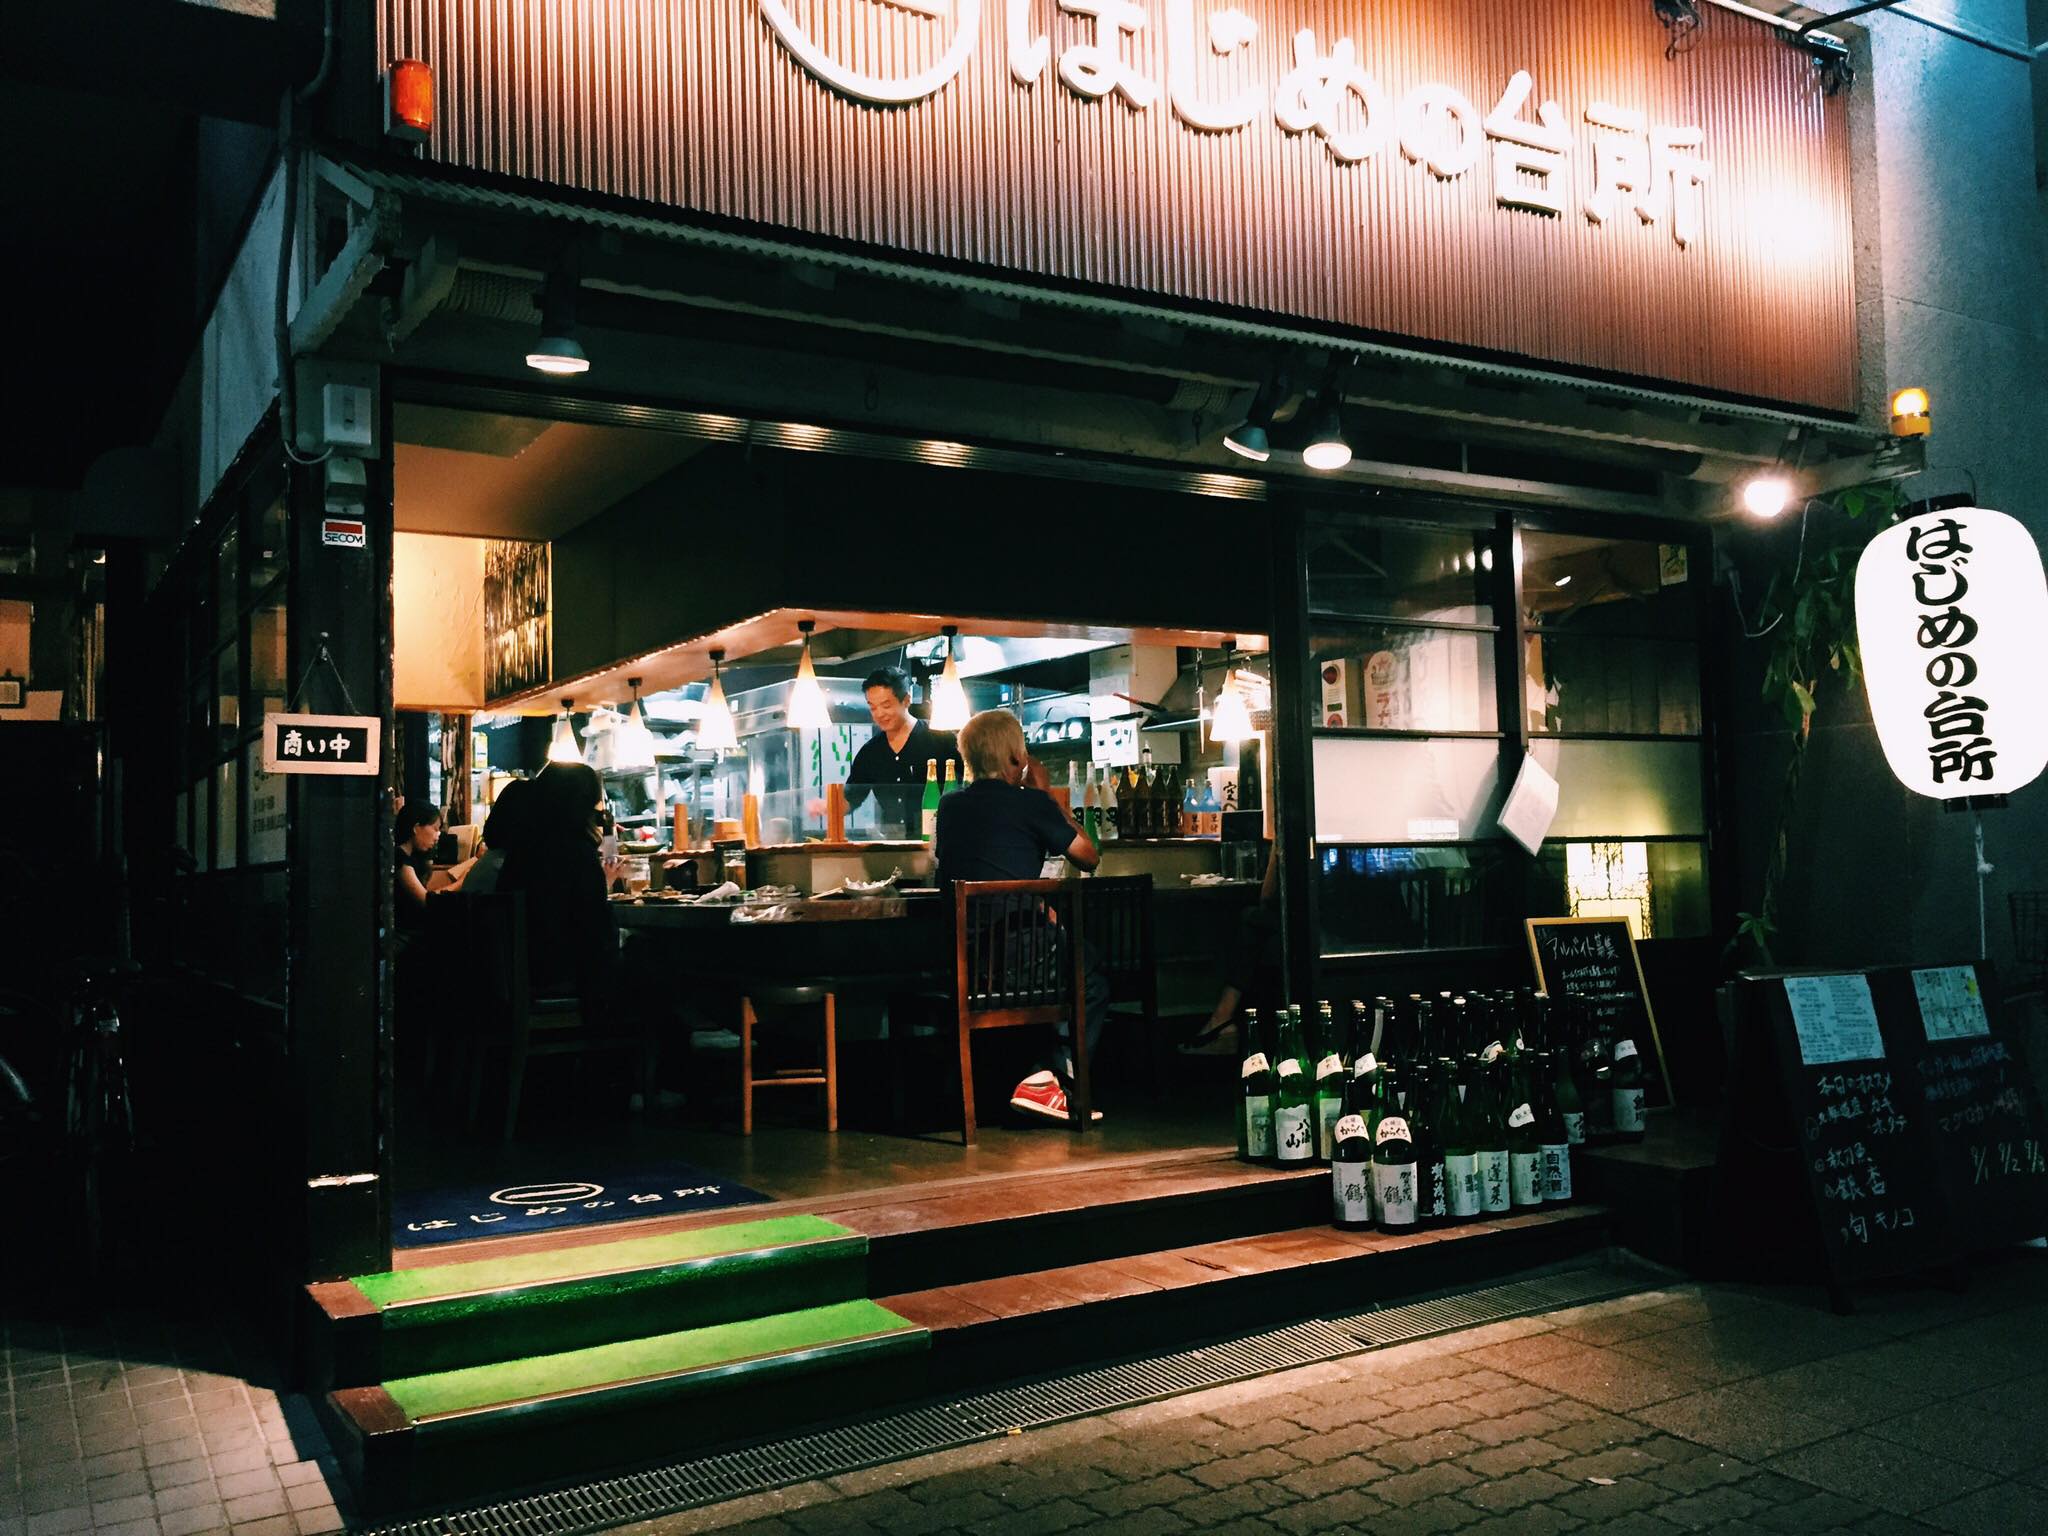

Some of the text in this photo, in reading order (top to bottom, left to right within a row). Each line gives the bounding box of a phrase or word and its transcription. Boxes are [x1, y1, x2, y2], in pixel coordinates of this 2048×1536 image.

[1008, 0, 1713, 248] はじめの台所
[324, 532, 363, 544] SECOM
[1906, 518, 1997, 783] はじめの台所
[284, 729, 351, 760] 商い中
[1545, 935, 1619, 960] アルバイト募集
[406, 1184, 721, 1232] はじめの台所
